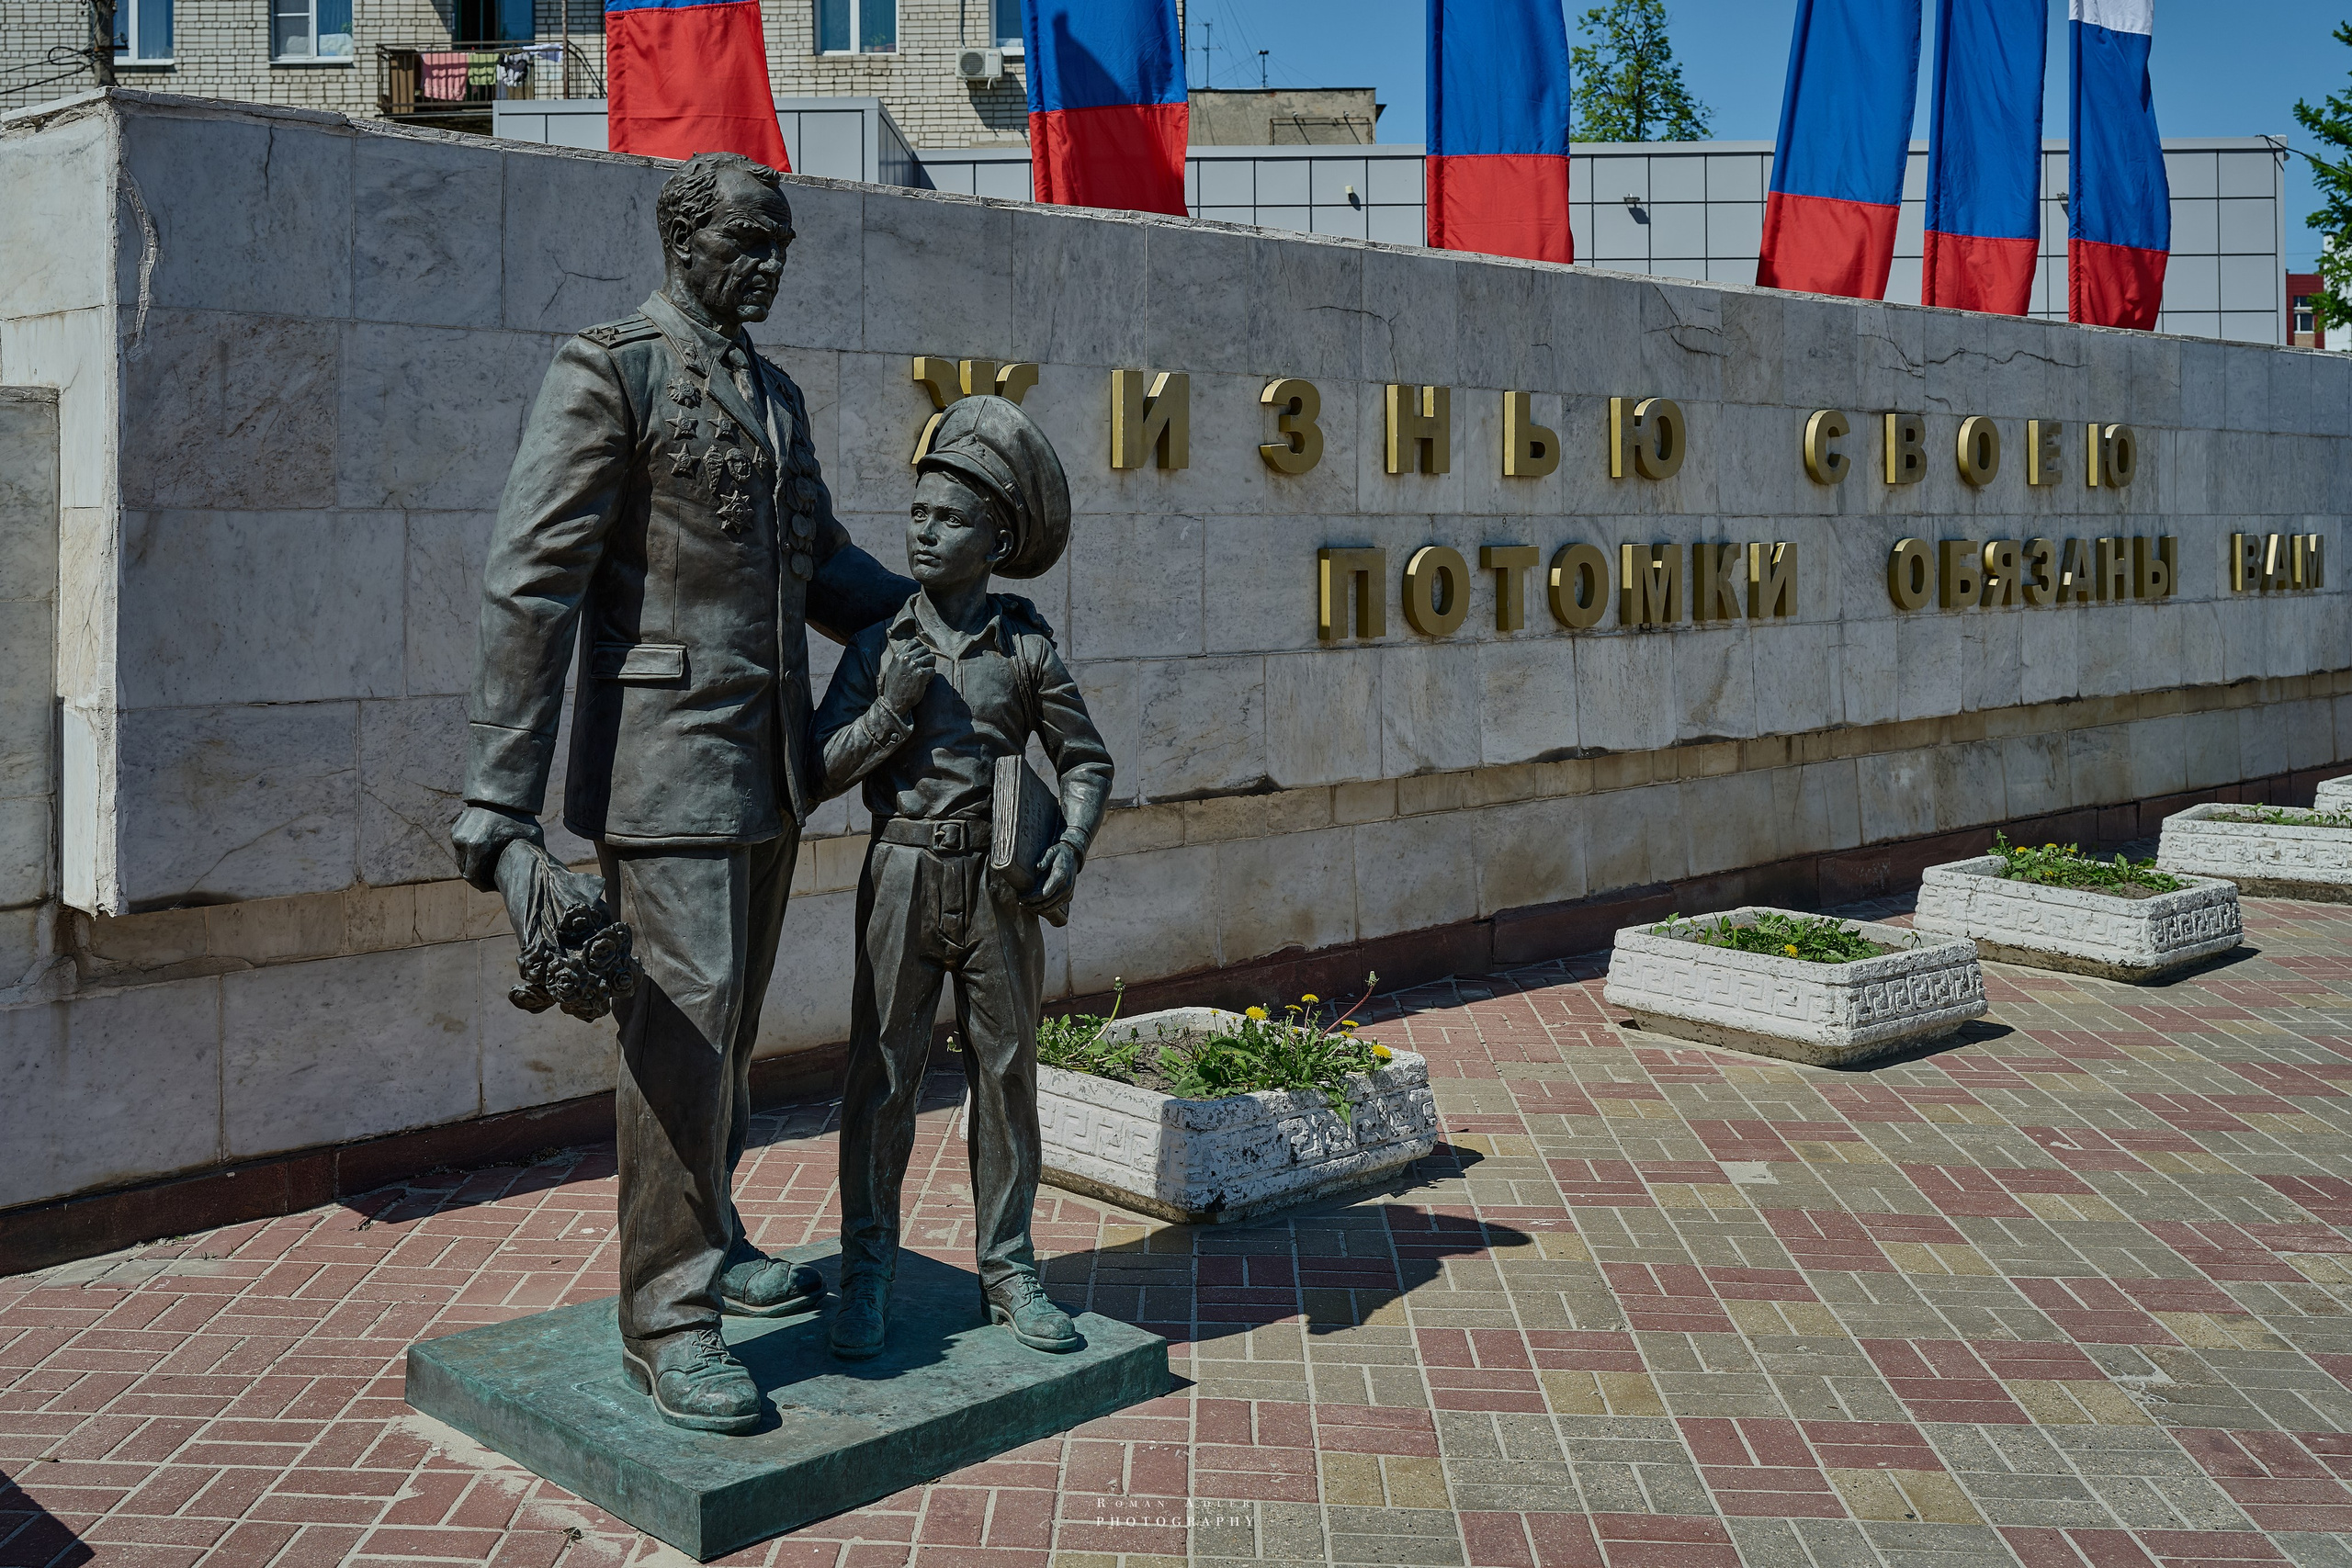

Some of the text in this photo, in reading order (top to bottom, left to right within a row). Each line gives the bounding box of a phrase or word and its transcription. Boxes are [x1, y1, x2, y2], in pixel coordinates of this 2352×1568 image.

[1804, 409, 2137, 488] СВОЕЮ
[1317, 532, 2325, 642] ПОТОМКИ ОБЯЗАНЫ ВАМ
